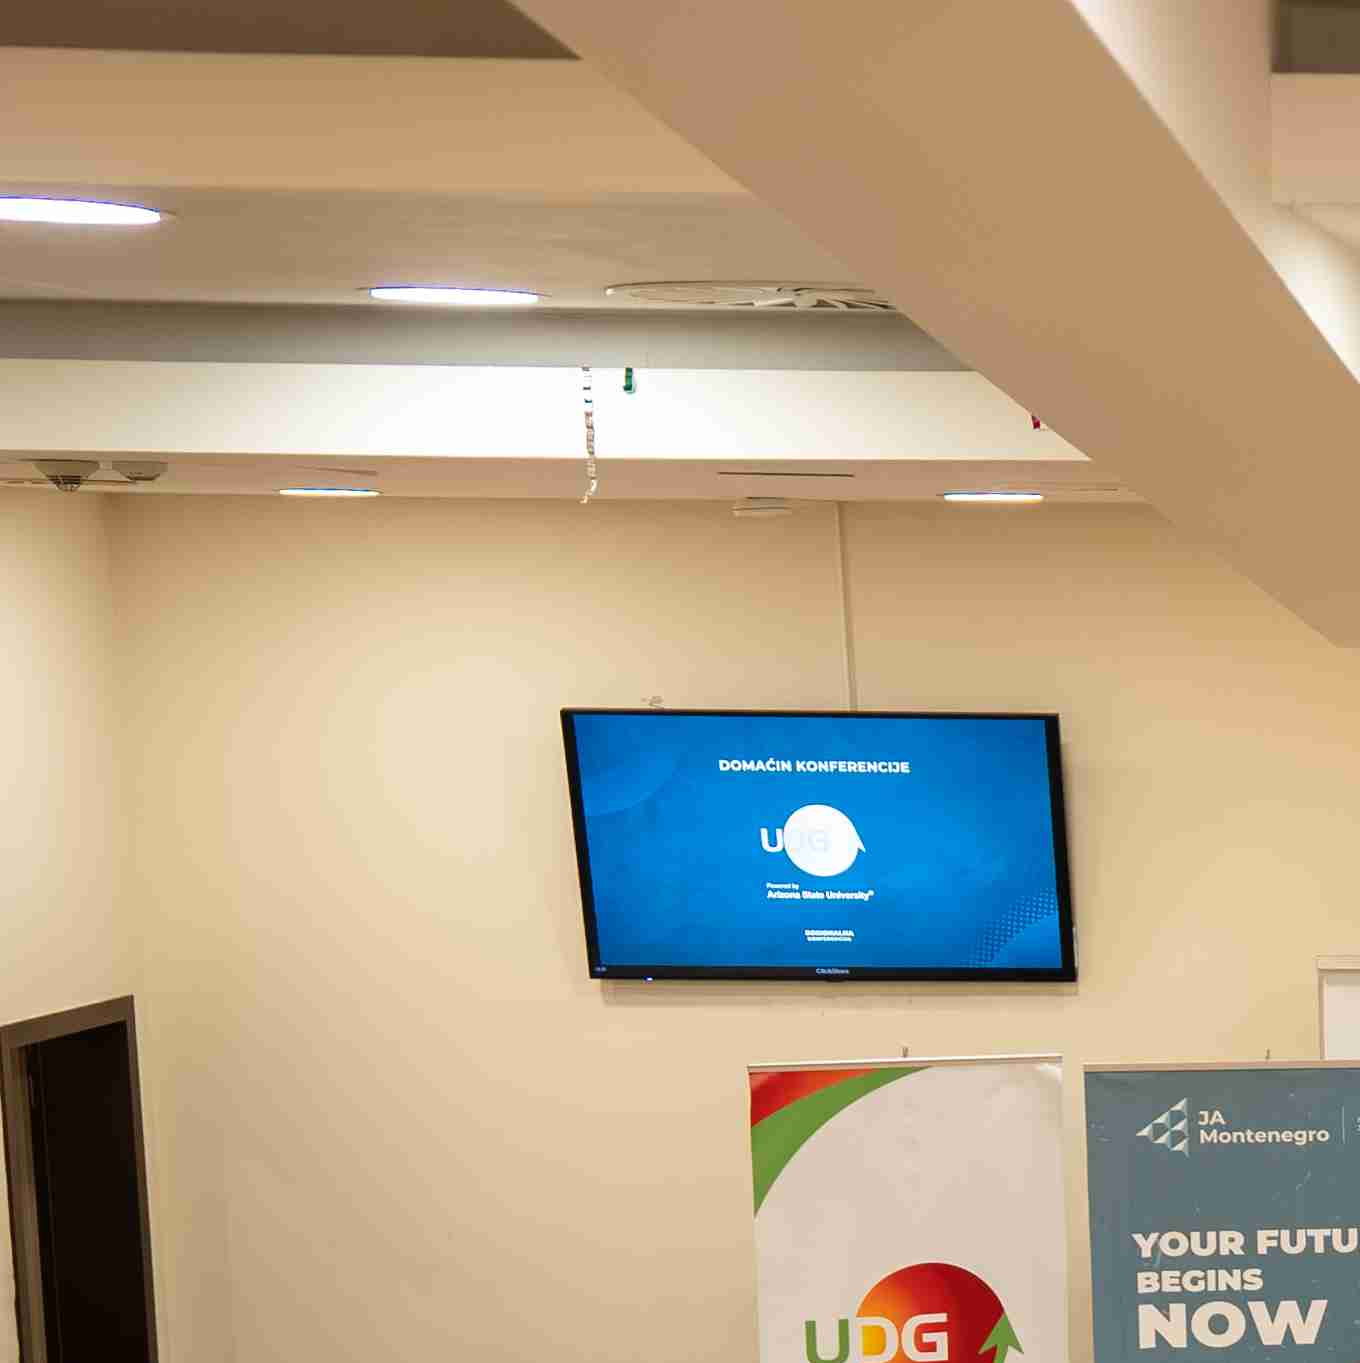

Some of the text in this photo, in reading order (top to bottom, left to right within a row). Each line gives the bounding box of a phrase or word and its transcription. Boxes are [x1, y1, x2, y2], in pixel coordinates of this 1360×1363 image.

[796, 759, 912, 774] KONFERENCIJE
[1198, 1110, 1226, 1126] JA
[1199, 1127, 1330, 1146] Montenegro
[1132, 1230, 1246, 1258] YOUR
[1136, 1268, 1264, 1293] BEGINS
[1137, 1299, 1328, 1349] NOW
